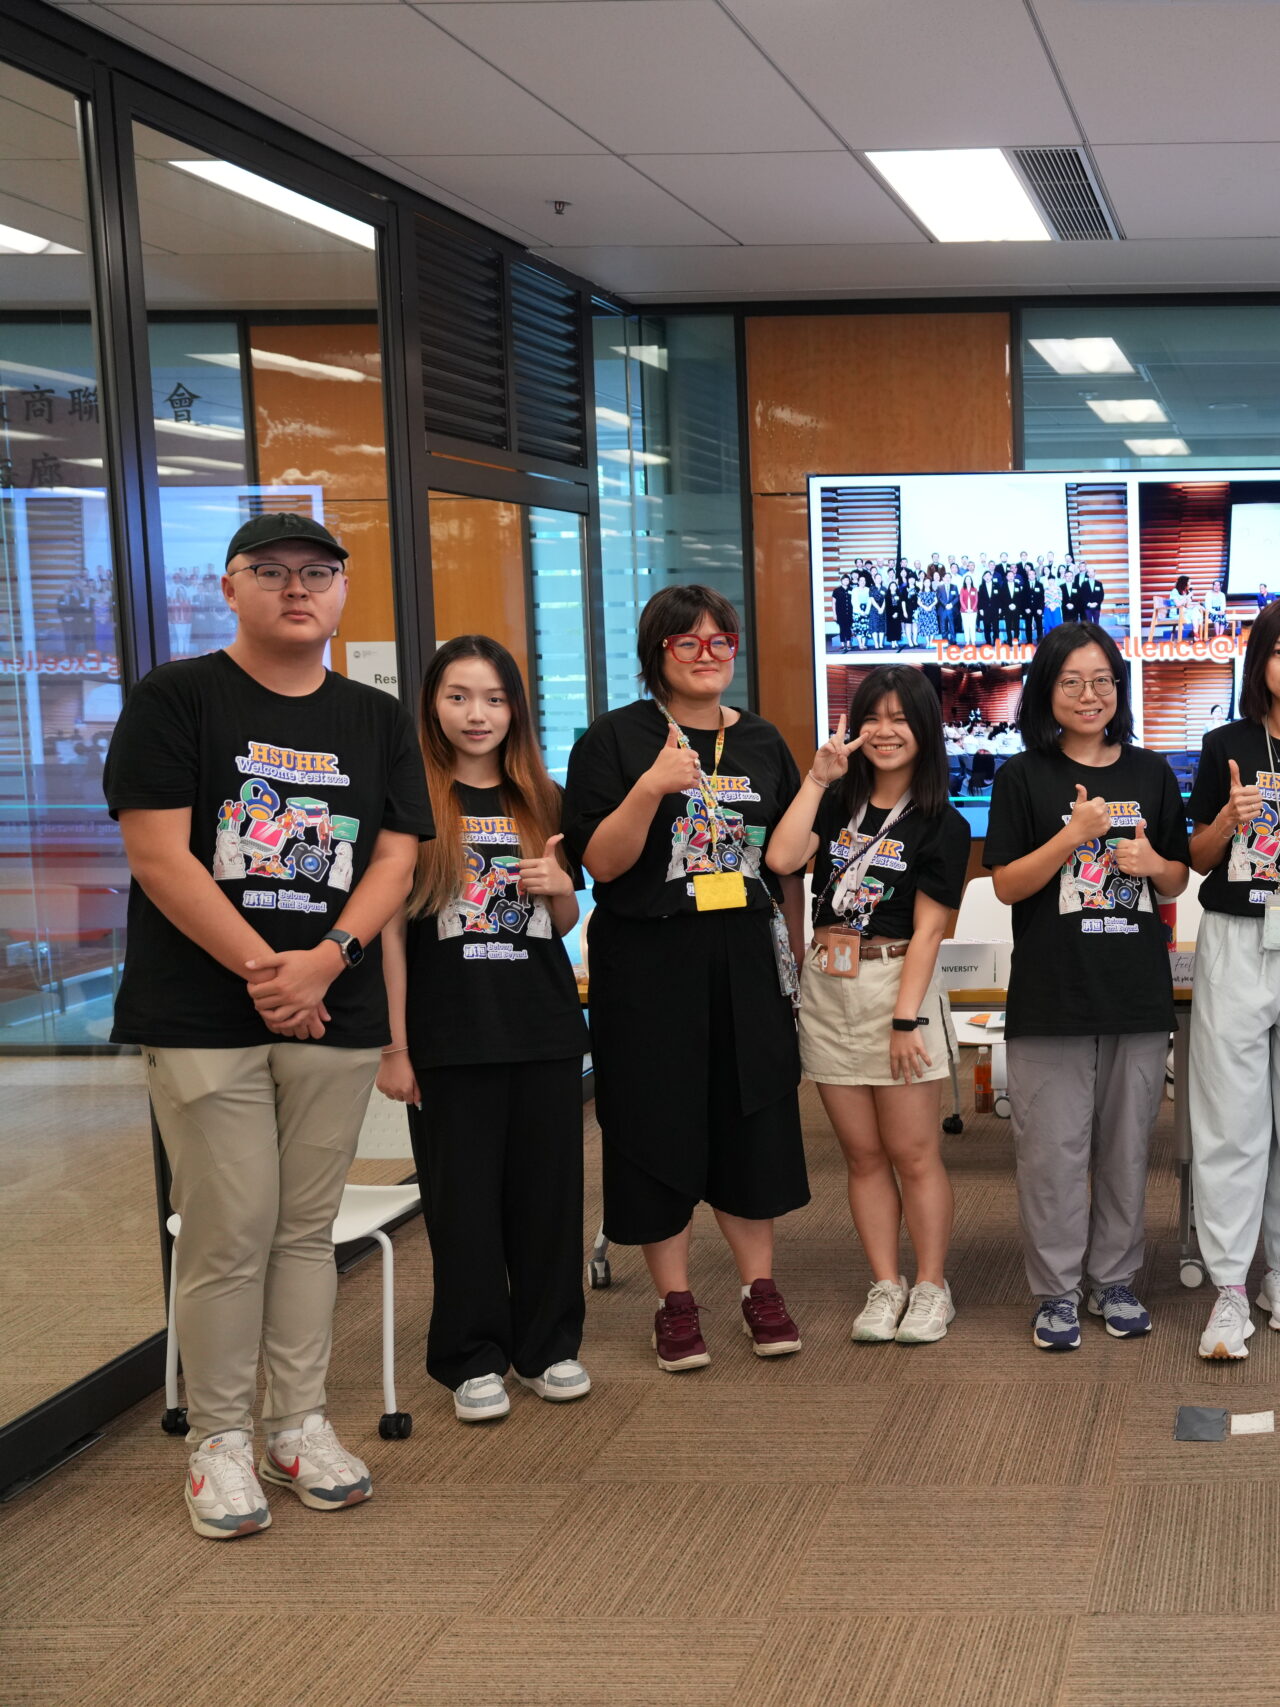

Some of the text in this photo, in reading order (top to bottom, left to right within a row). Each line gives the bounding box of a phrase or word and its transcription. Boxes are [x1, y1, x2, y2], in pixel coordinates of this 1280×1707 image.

[932, 638, 1036, 661] Teachin
[374, 673, 398, 685] Res
[251, 744, 337, 773] HSUHK
[237, 758, 296, 781] Welcome
[298, 771, 326, 784] Fest
[499, 834, 519, 843] Fes
[941, 965, 979, 973] NIVERSITY
